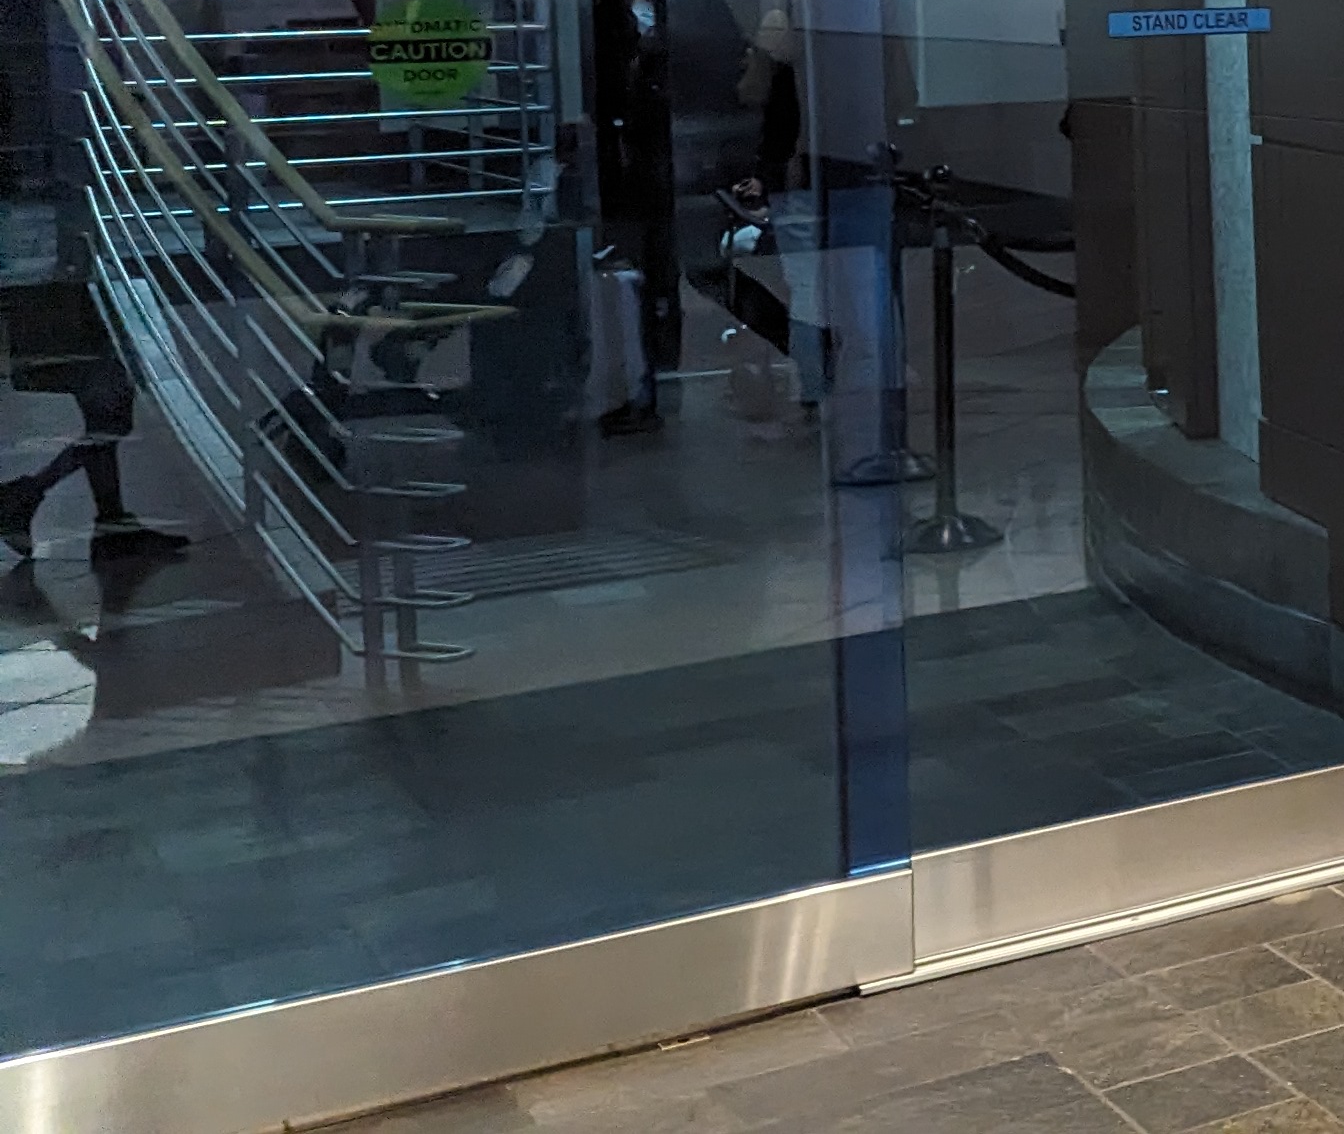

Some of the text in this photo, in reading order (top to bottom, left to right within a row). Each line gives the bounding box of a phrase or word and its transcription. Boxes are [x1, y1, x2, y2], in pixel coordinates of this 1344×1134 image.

[1132, 12, 1249, 32] STAND CLEAR
[370, 42, 487, 61] CAUTION
[403, 69, 459, 83] DOOR
